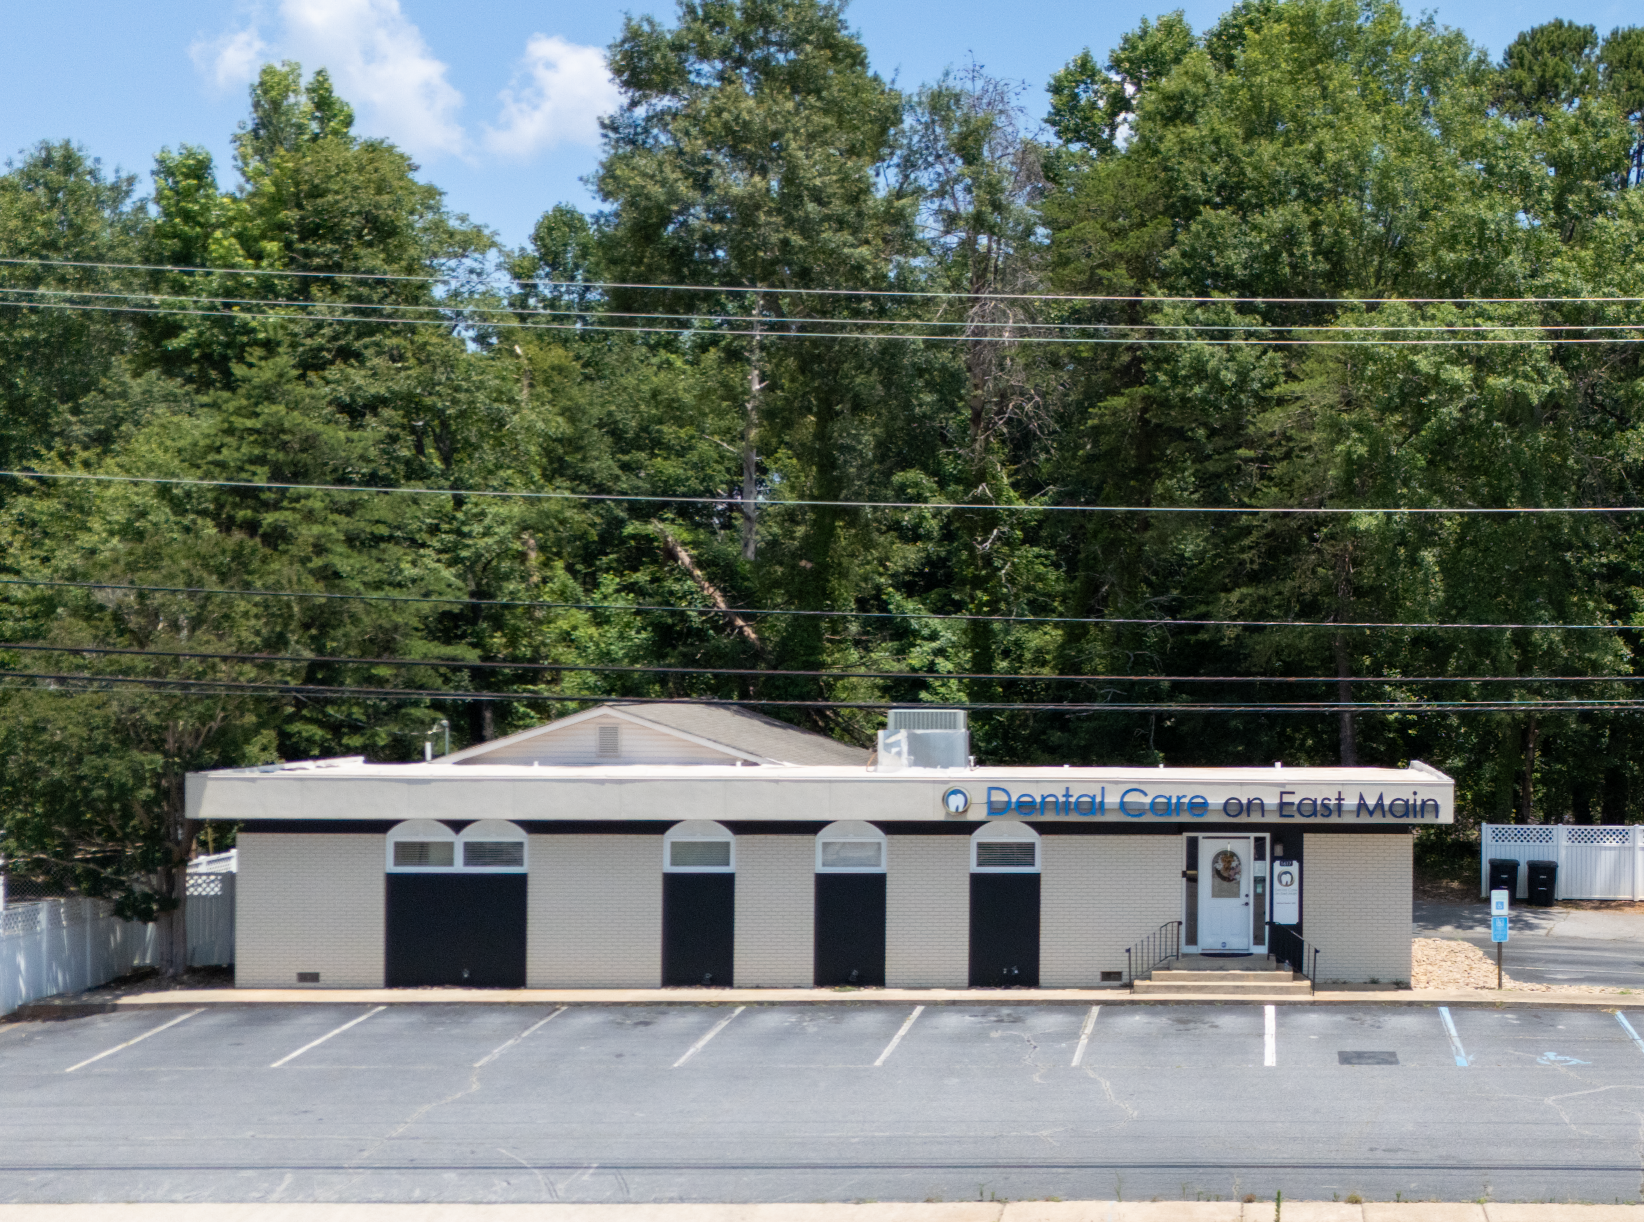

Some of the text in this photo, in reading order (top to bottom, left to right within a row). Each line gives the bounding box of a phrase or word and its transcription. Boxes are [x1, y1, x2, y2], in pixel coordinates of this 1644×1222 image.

[986, 786, 1440, 819] Dental Care on East Main
